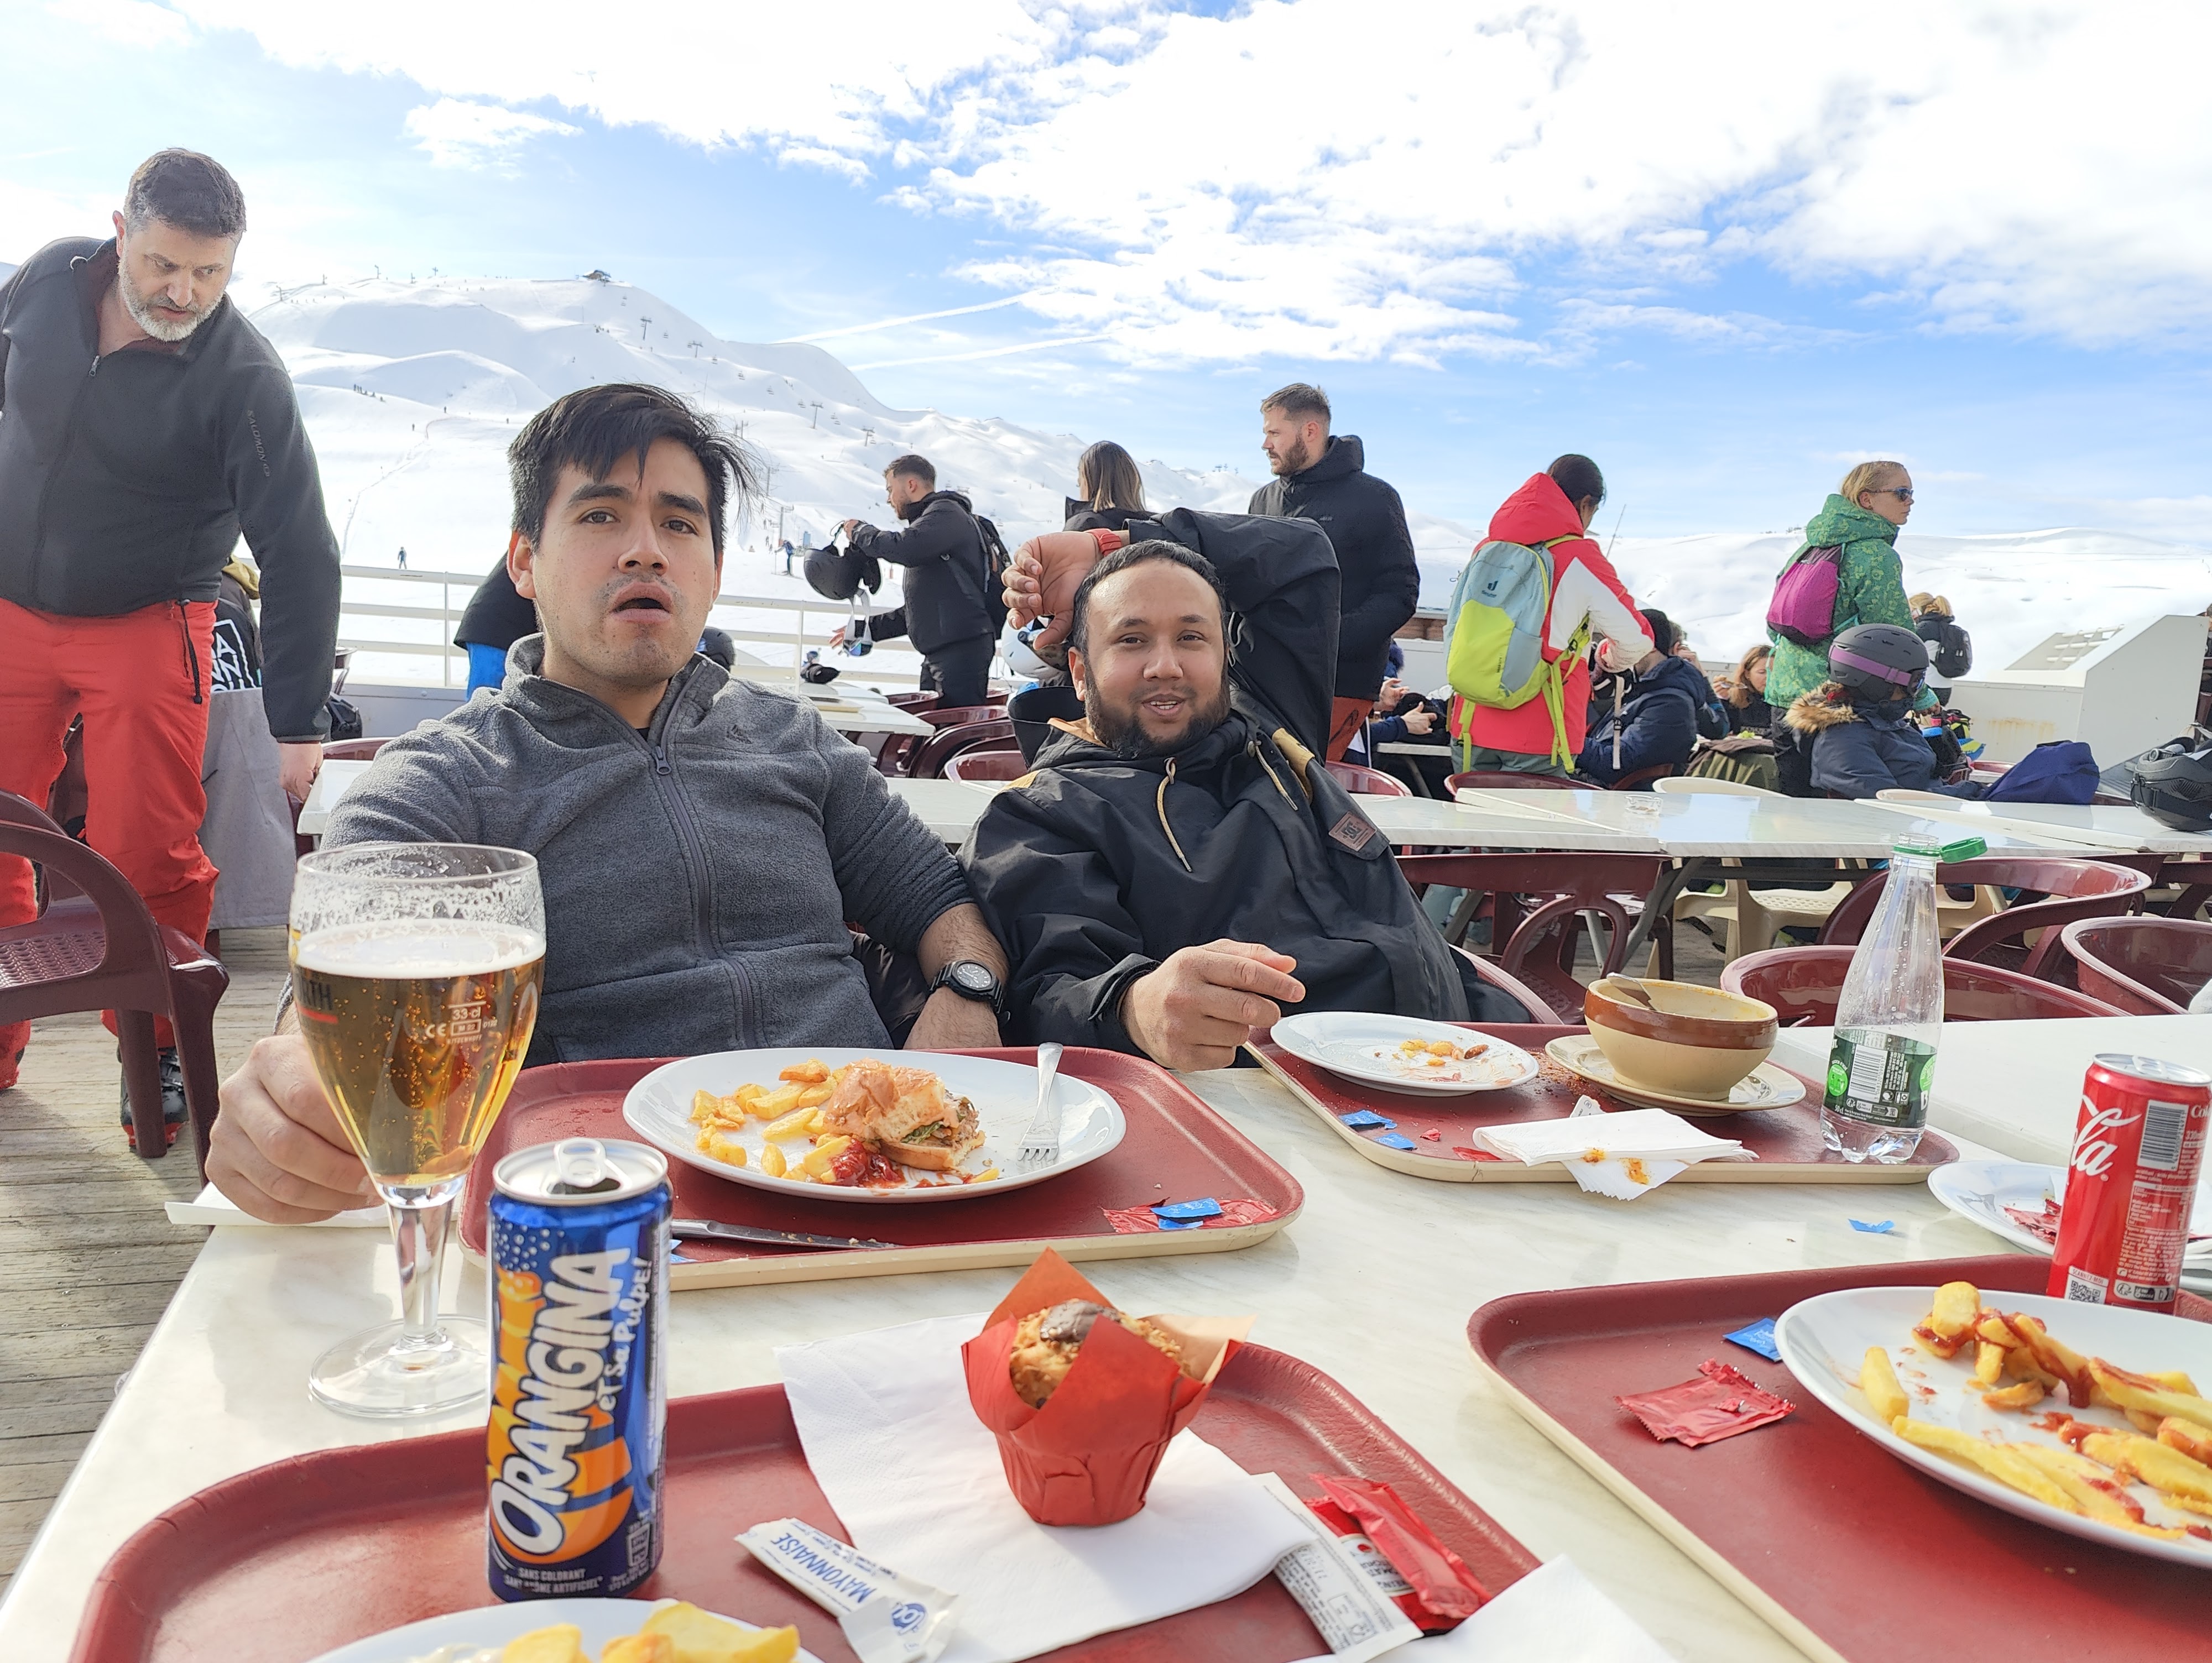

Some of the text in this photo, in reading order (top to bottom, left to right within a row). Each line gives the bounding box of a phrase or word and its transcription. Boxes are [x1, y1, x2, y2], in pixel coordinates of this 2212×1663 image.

[247, 409, 267, 462] SALOMON
[211, 632, 237, 659] A
[453, 1006, 481, 1021] 33 cl
[492, 1247, 632, 1556] ORANGINA
[518, 1568, 586, 1581] SANS COLORANT
